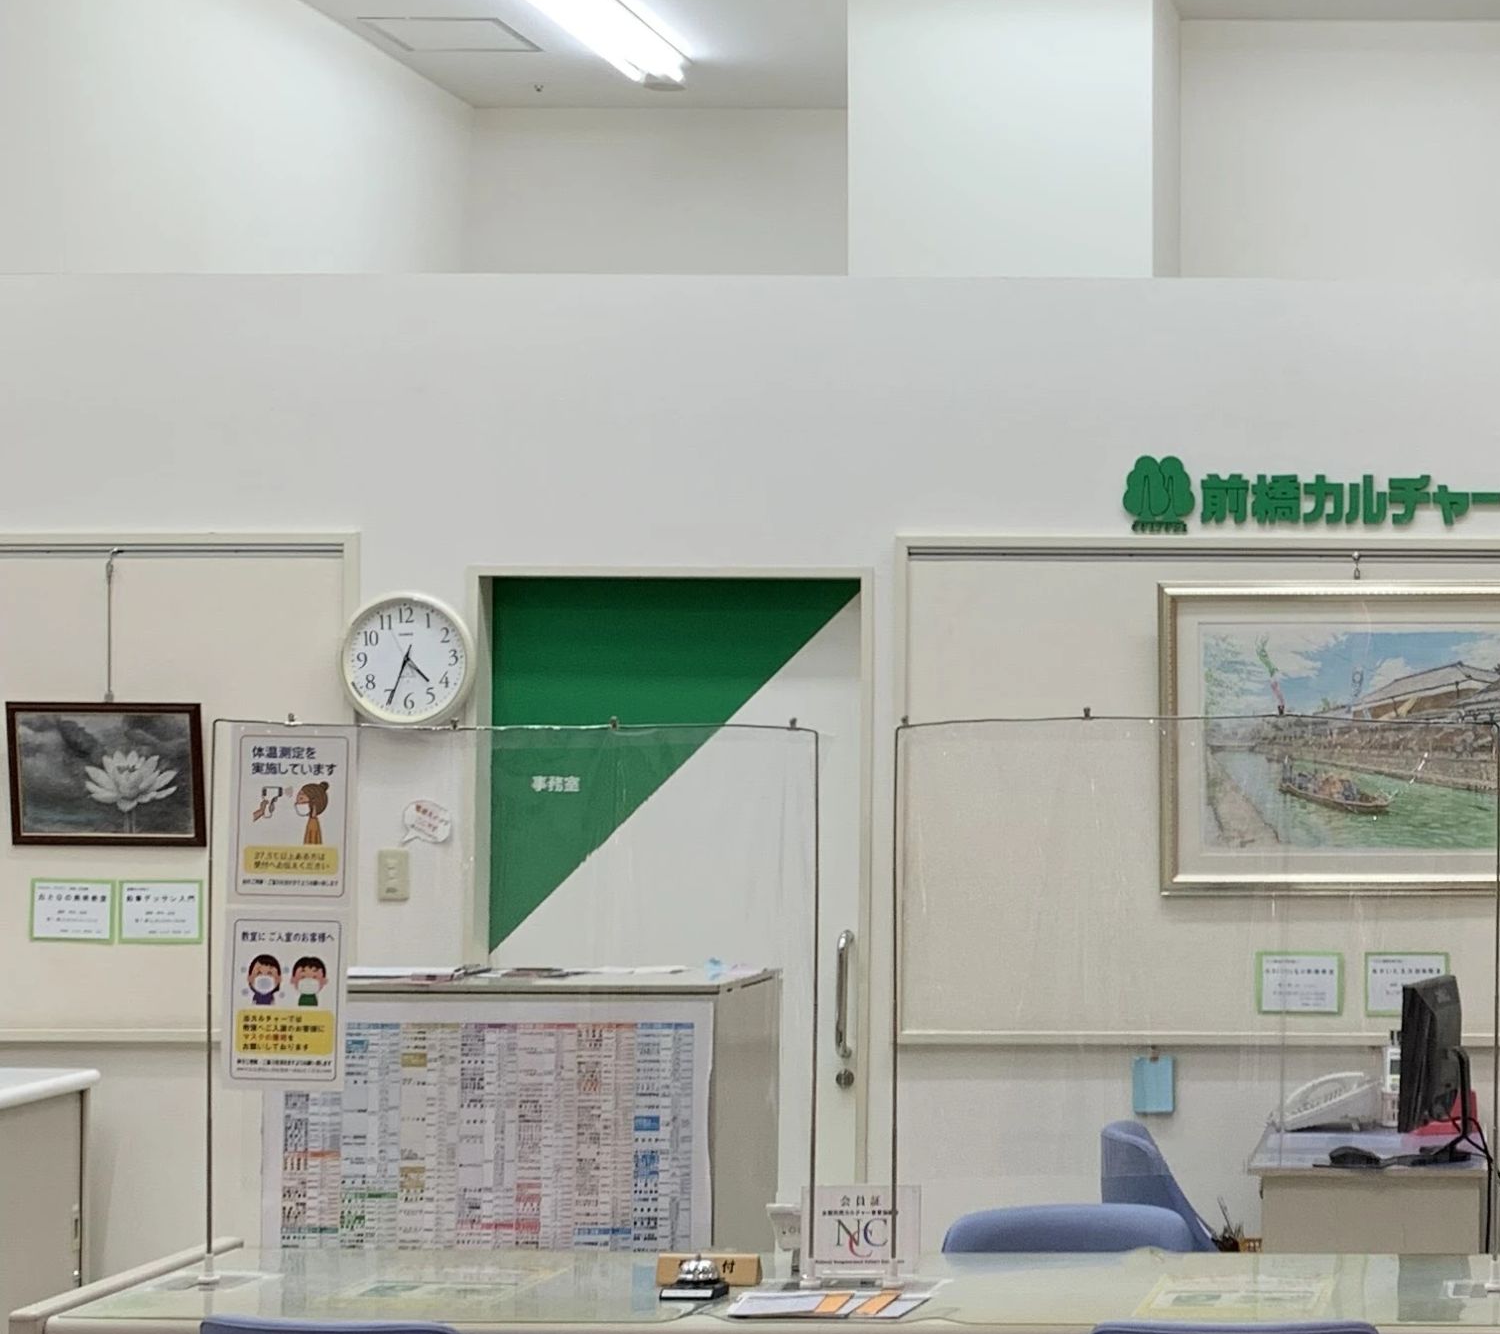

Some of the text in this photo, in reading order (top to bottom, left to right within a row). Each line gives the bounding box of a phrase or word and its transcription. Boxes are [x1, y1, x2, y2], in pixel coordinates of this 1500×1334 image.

[380, 614, 392, 630] 11
[399, 606, 414, 624] 12
[426, 612, 431, 629] 1
[364, 630, 379, 647] 10
[440, 626, 451, 643] 2
[356, 652, 368, 669] 9
[448, 649, 459, 666] 3
[365, 673, 376, 690] 8
[439, 670, 449, 688] 4
[403, 692, 415, 709] 6
[425, 687, 436, 705] 5
[252, 746, 316, 760] 体温測定を
[251, 762, 337, 776] 実施しています
[531, 775, 581, 792] 事務室
